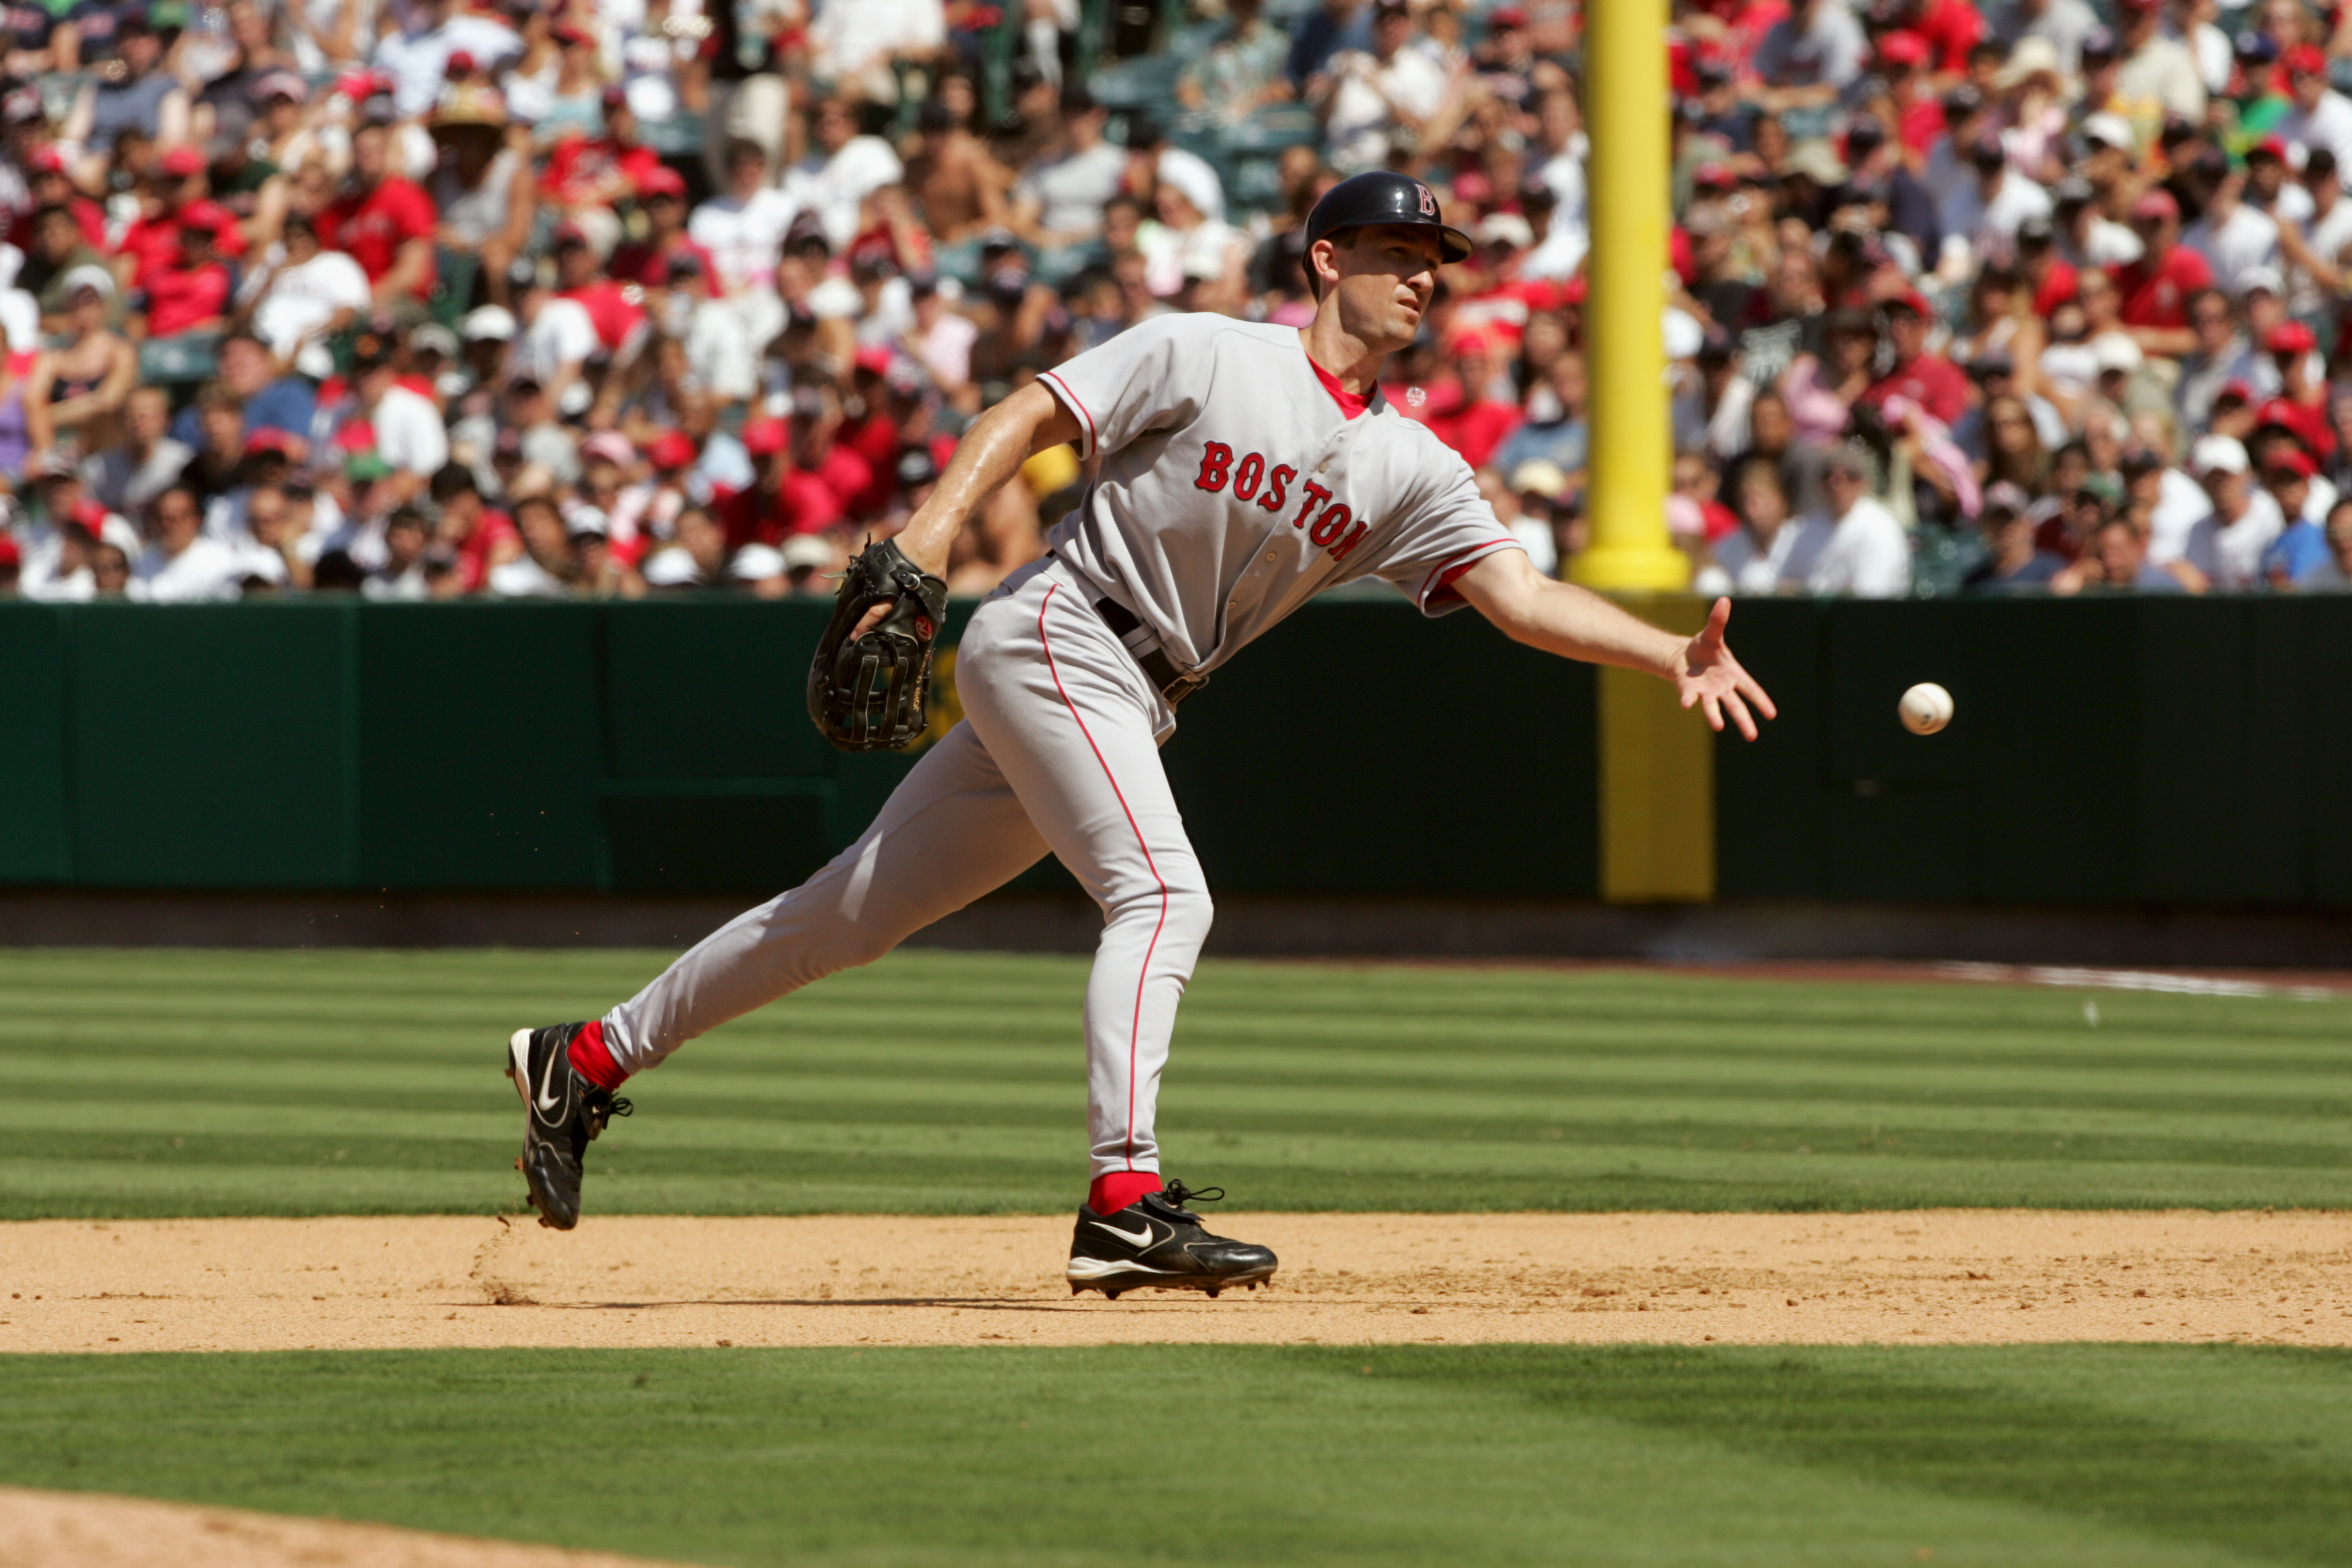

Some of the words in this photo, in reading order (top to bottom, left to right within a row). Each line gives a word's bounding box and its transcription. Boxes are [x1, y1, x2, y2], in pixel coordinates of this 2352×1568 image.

[1415, 183, 1435, 216] B
[1193, 440, 1372, 562] BOSTON
[913, 687, 921, 712] JOHN
